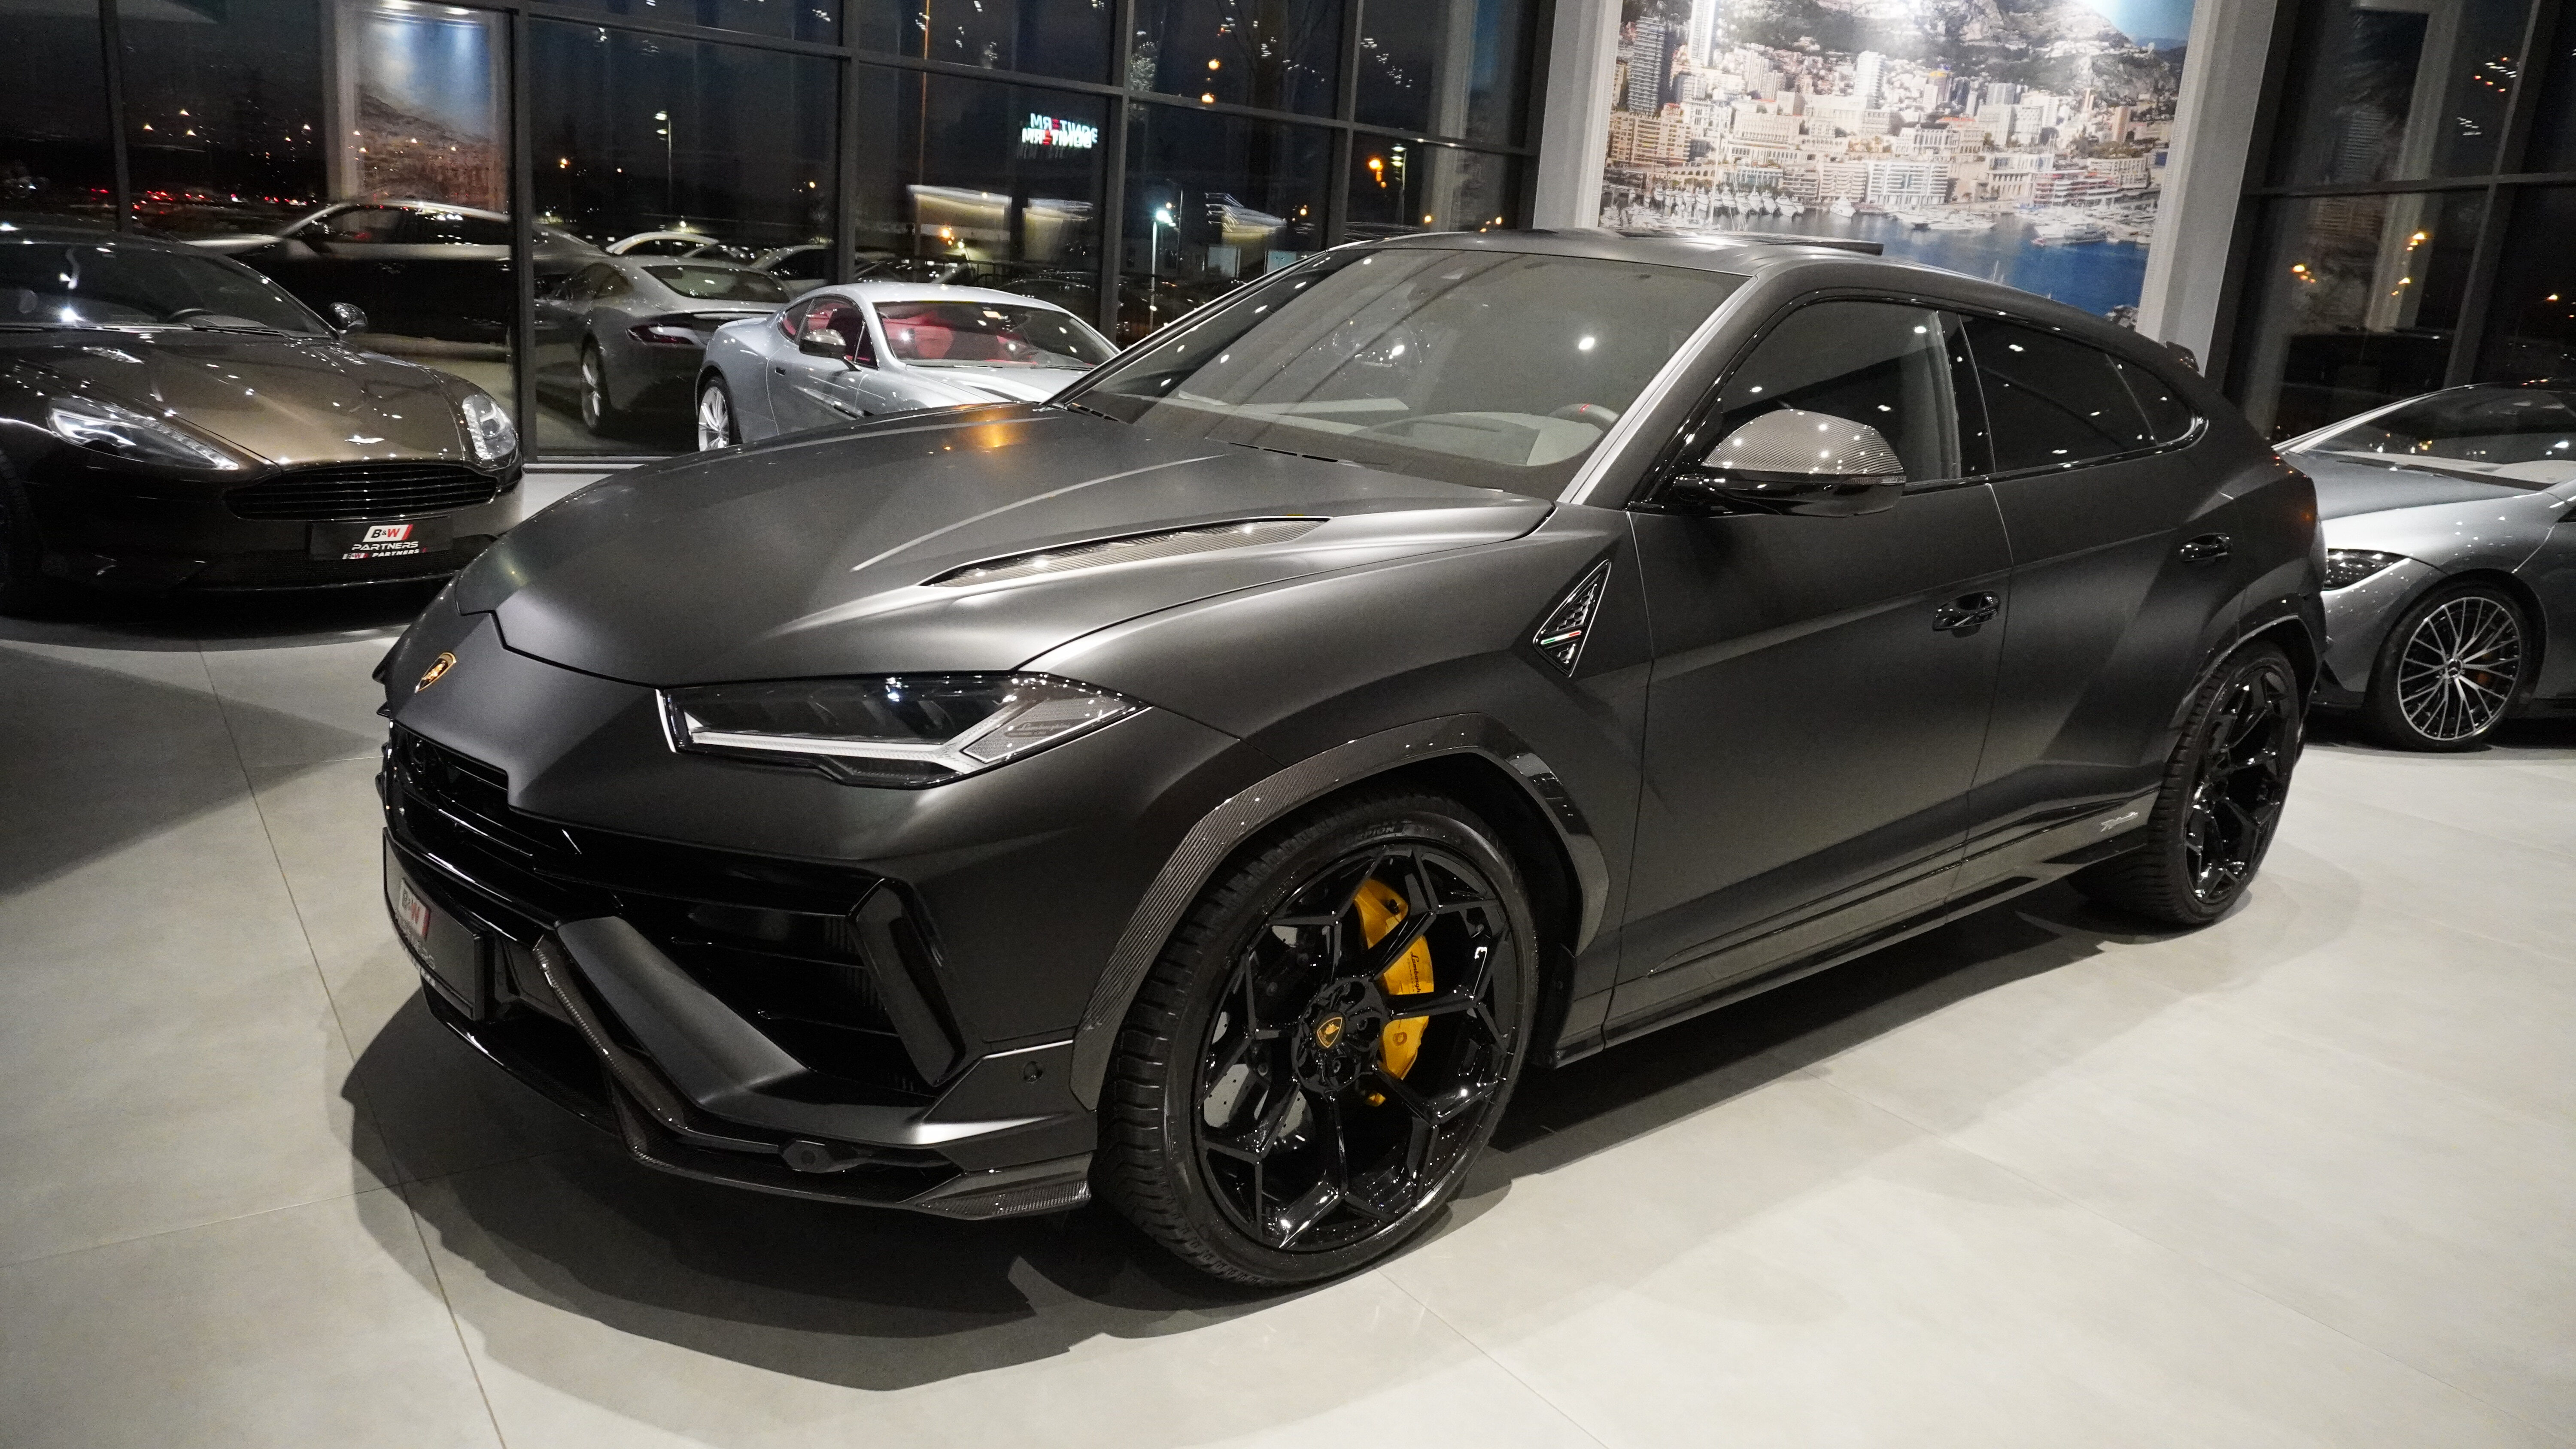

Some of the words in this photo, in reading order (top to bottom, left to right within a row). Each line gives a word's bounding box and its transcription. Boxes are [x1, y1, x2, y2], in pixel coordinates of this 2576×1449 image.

[371, 528, 401, 538] B&W
[351, 541, 419, 551] PARTNERS
[372, 549, 419, 557] PARTNERS
[1410, 951, 1422, 993] Lamborgh
